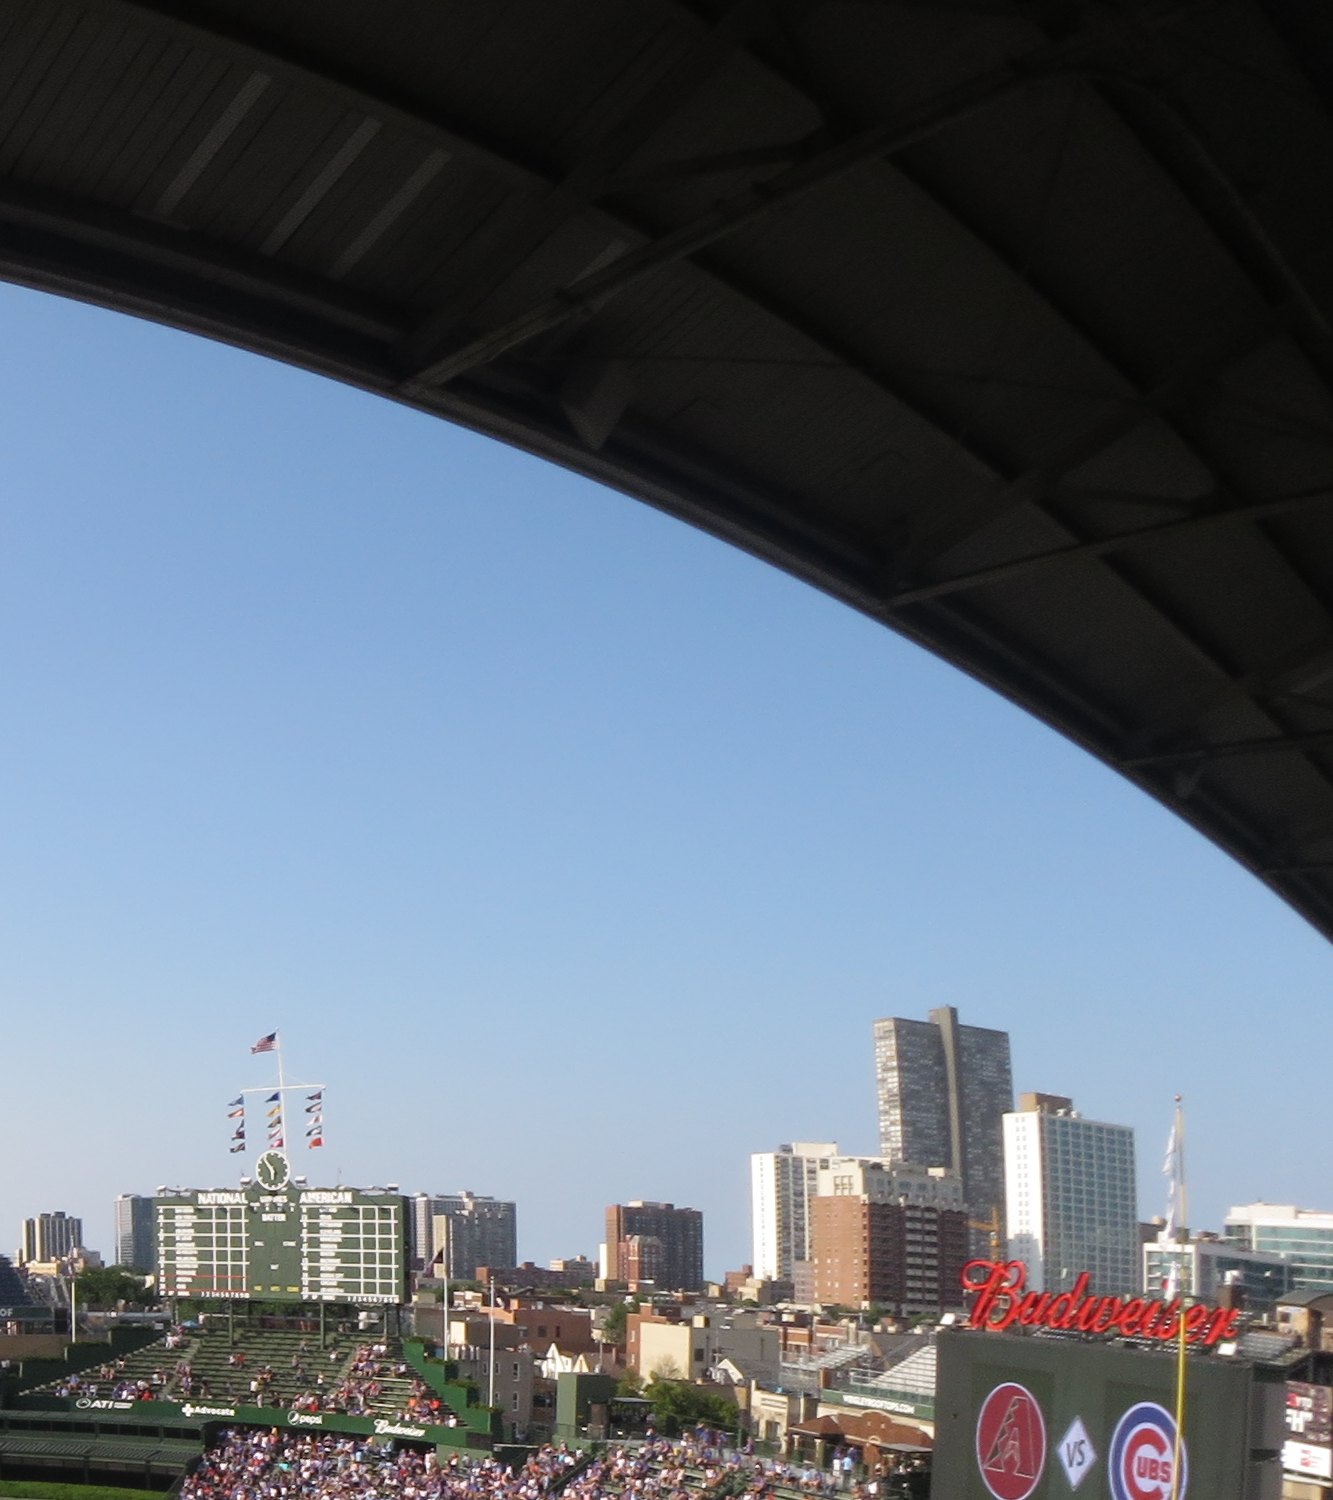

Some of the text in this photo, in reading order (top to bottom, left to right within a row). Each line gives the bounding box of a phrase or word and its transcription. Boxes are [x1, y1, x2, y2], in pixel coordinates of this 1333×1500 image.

[197, 1192, 248, 1205] NATIONAL
[299, 1191, 353, 1204] AMERICAN
[960, 1259, 1241, 1345] Budweiser
[90, 1400, 113, 1409] ATI
[194, 1404, 235, 1418] Advocate
[298, 1413, 323, 1426] pepsi
[1066, 1439, 1085, 1469] VS
